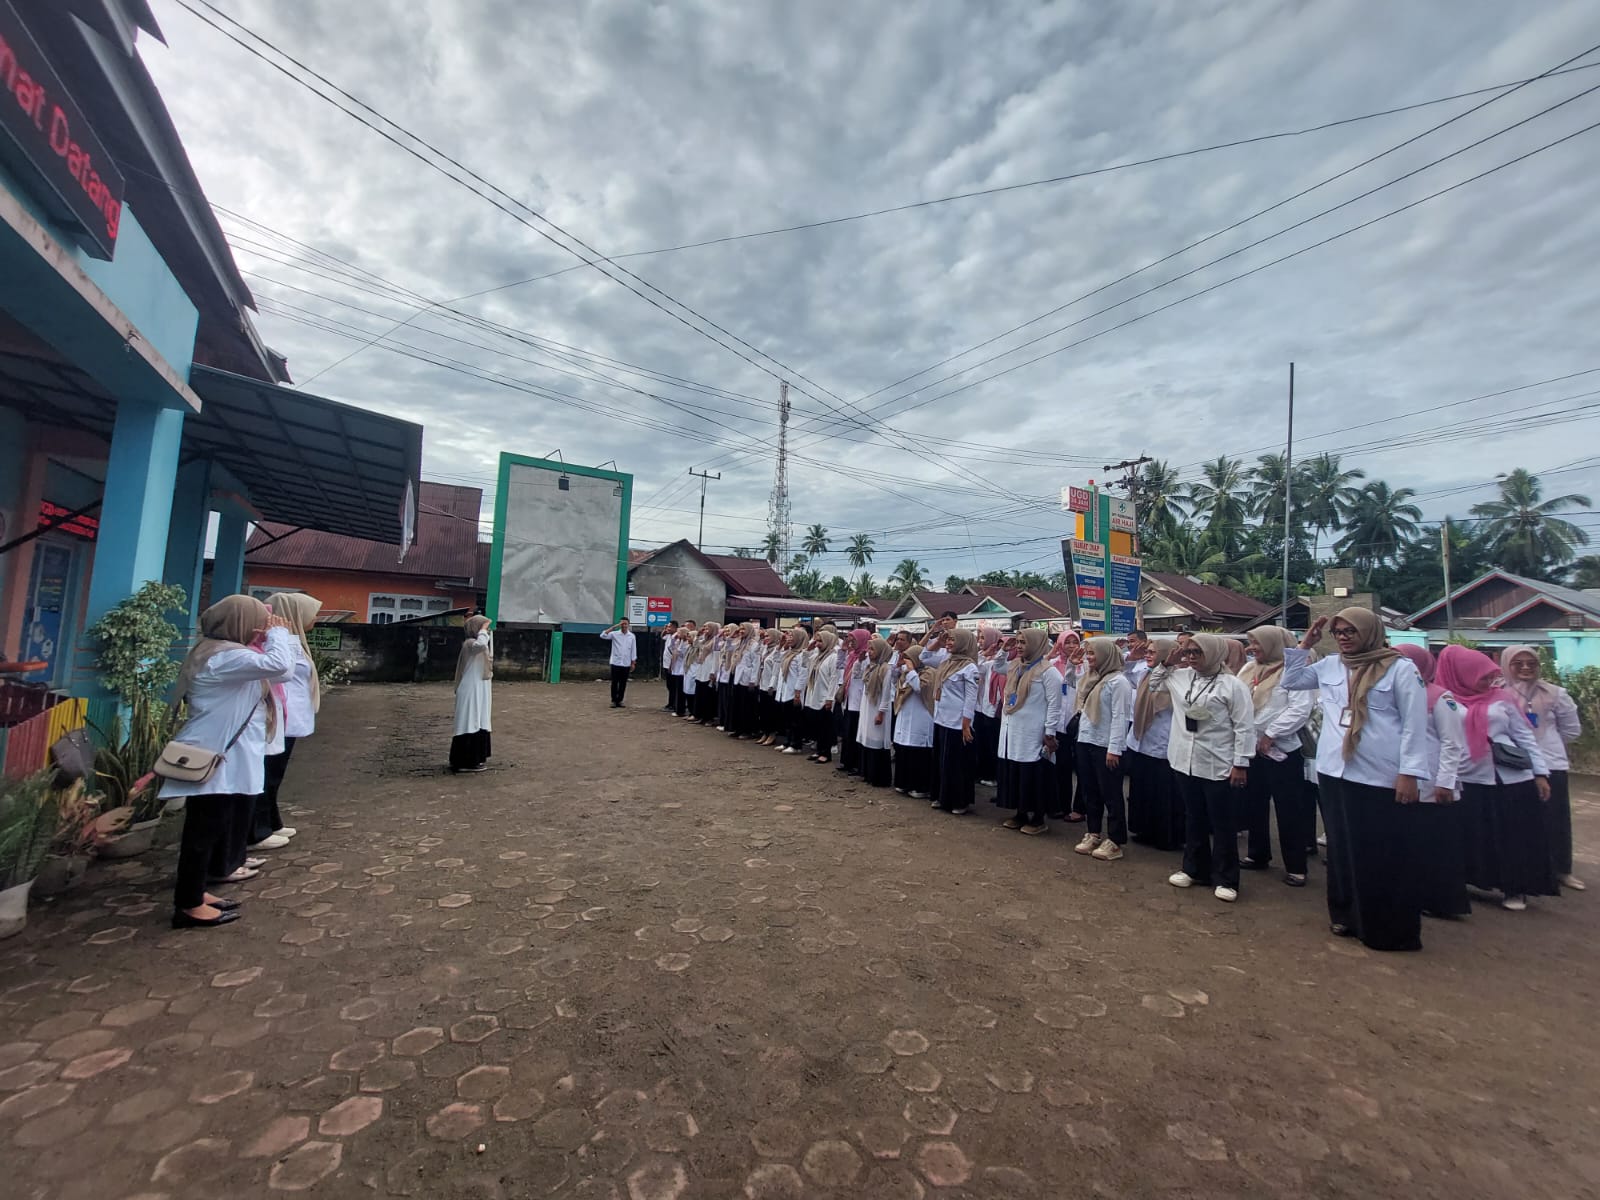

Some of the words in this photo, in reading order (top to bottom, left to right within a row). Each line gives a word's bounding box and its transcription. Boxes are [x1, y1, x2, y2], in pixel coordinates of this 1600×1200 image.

[49, 104, 121, 239] Datang
[1071, 488, 1088, 499] UGD
[1122, 519, 1133, 527] HAJI
